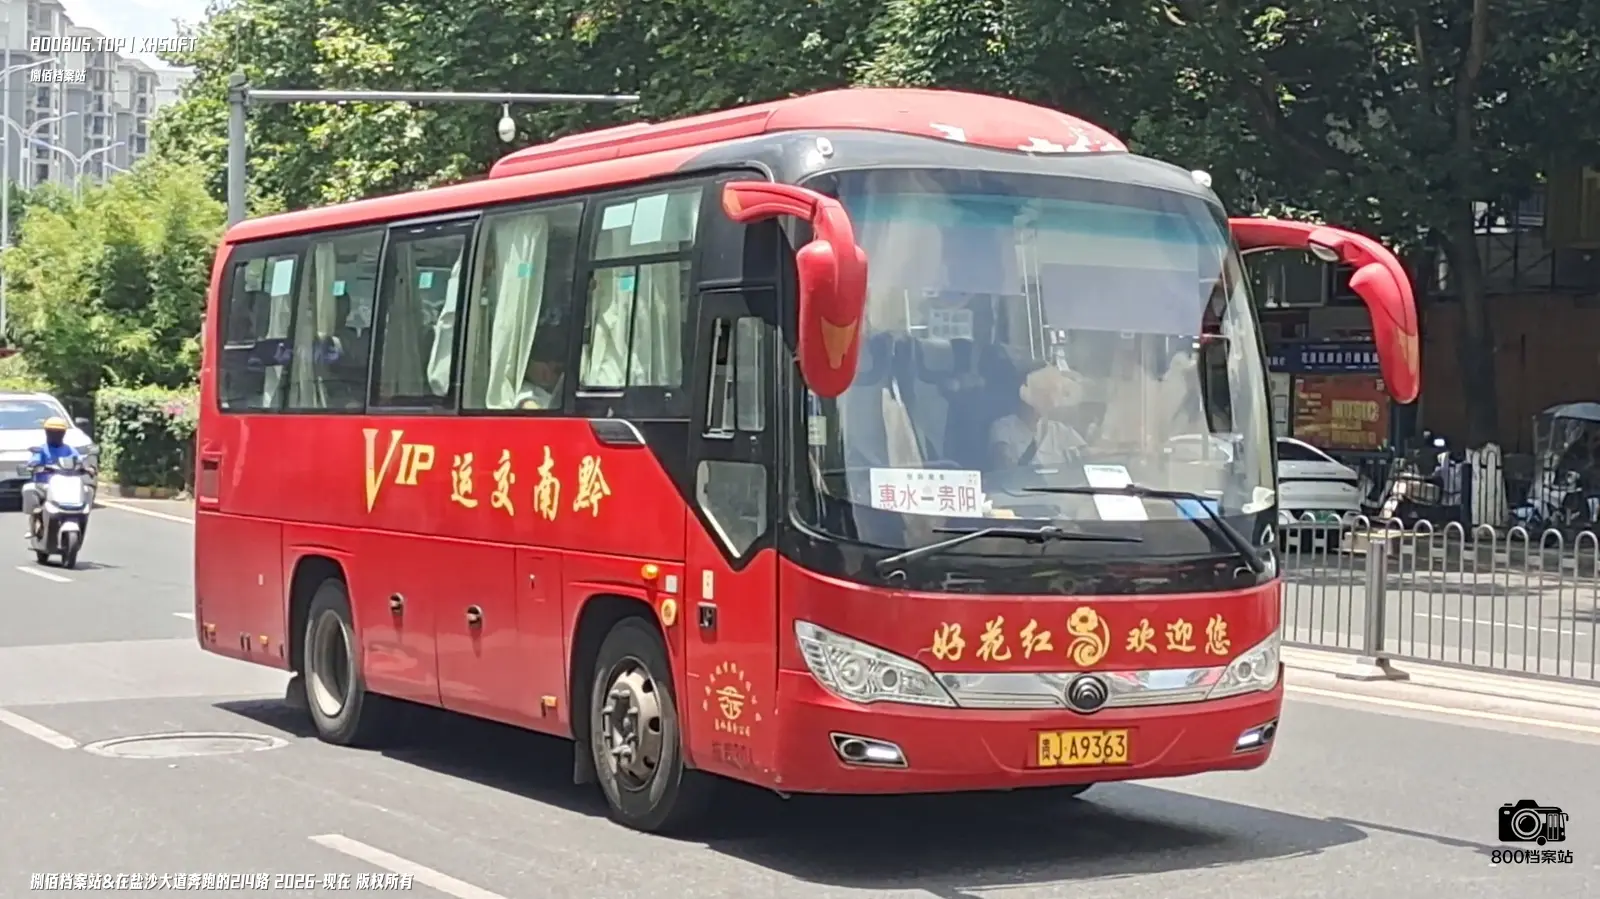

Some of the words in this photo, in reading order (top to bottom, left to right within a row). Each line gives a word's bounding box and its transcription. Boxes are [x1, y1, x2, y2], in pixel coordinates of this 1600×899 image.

[362, 428, 435, 514] VIP
[931, 615, 1054, 662] 好花红
[1126, 613, 1231, 656] 欢迎您
